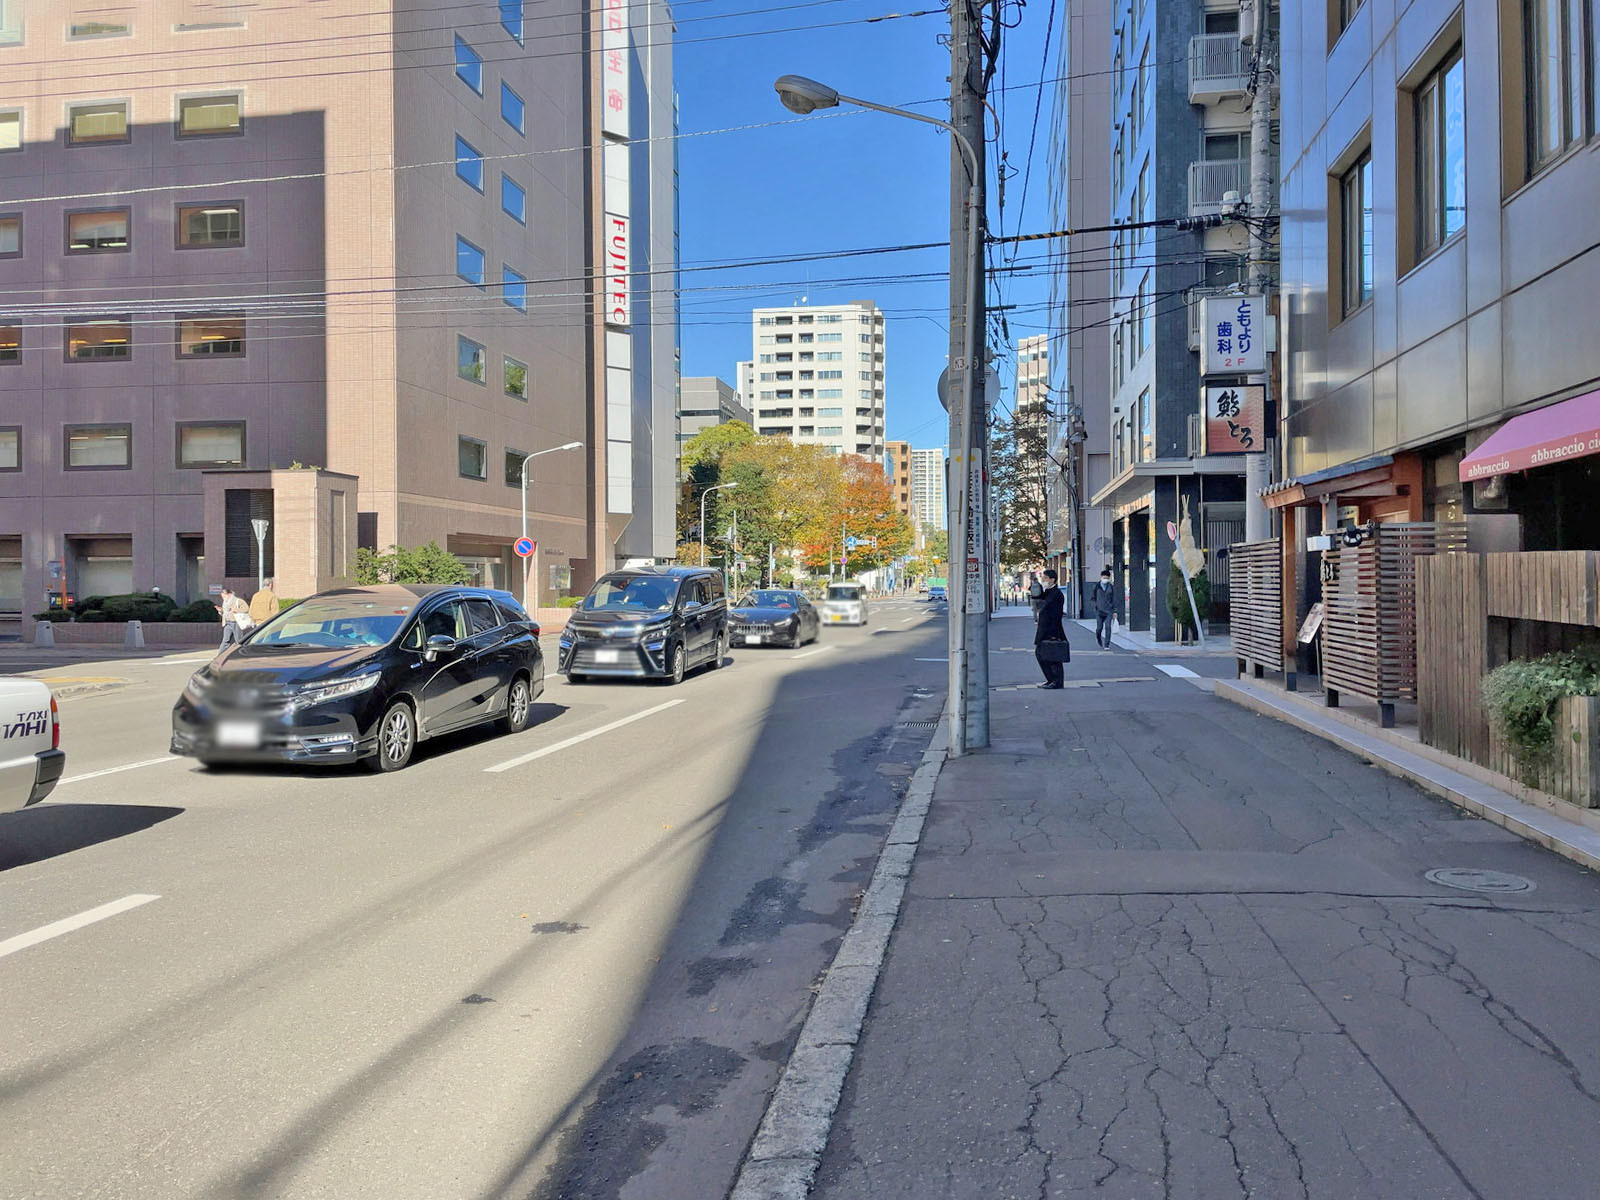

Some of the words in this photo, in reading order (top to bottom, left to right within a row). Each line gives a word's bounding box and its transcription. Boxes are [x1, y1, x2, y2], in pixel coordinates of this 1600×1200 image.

[608, 218, 626, 323] FUJITEC
[1216, 321, 1233, 355] 歯科
[1237, 299, 1252, 354] ともより
[1531, 438, 1585, 464] abbraccio
[1468, 457, 1510, 478] abbraccio
[17, 710, 48, 722] TAXI
